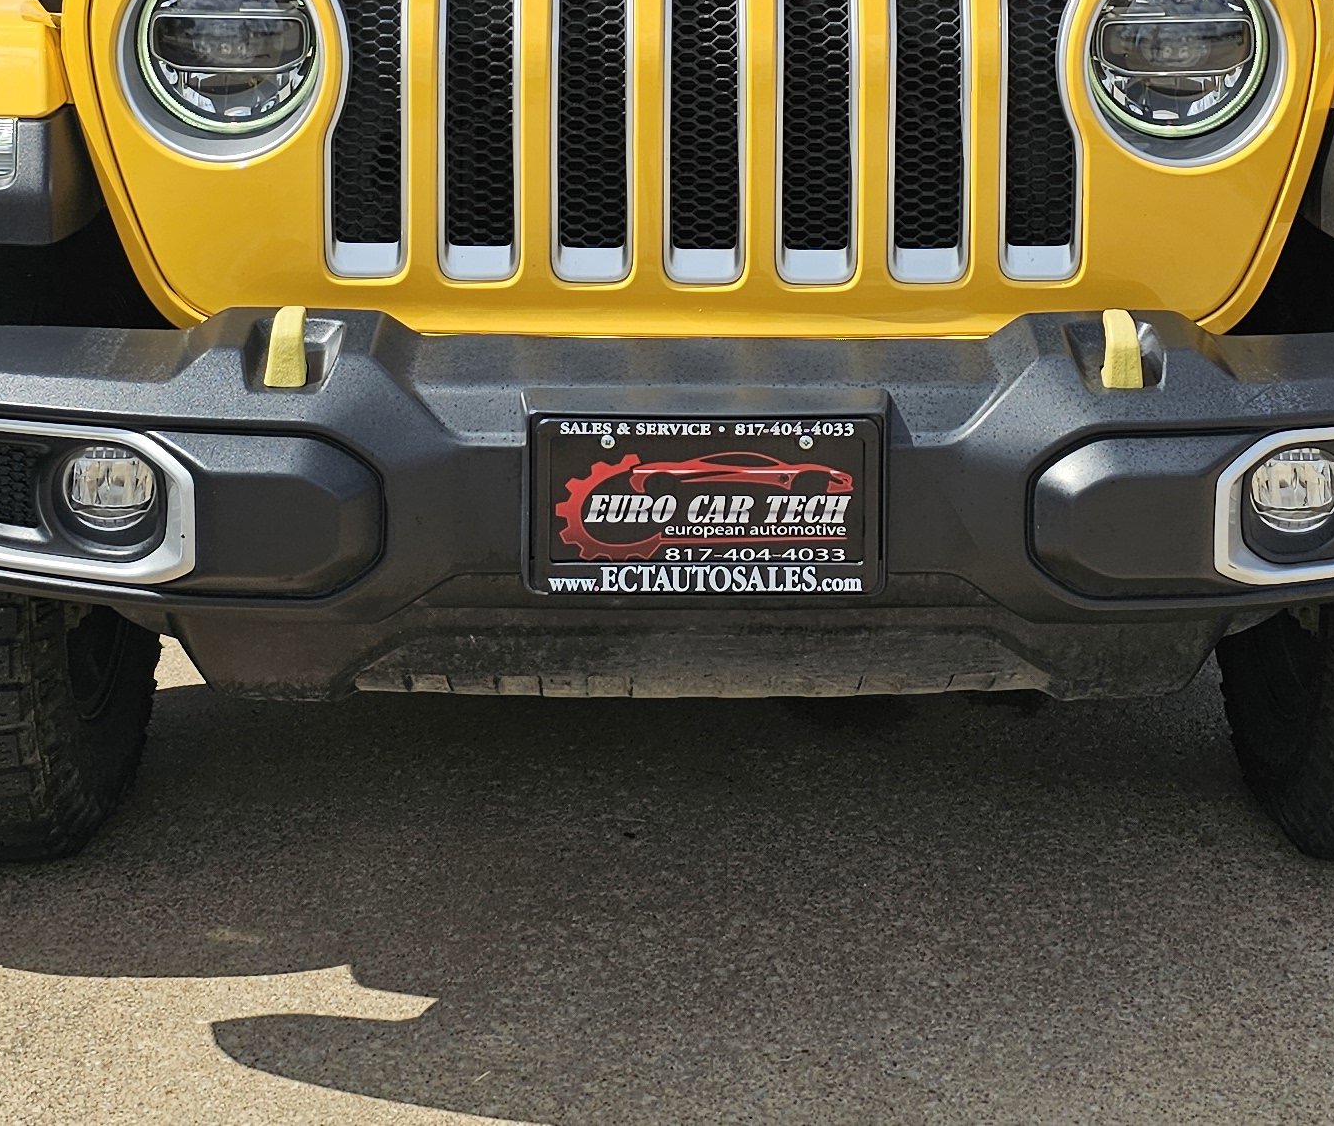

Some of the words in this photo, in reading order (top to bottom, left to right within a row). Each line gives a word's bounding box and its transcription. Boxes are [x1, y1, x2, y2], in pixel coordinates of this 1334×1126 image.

[559, 422, 613, 436] SALES
[616, 423, 631, 436] &
[635, 422, 712, 436] SERVICE
[734, 421, 855, 437] 817-404-4033
[583, 494, 677, 524] EURO
[686, 494, 755, 524] CAR
[763, 494, 852, 524] TECH
[664, 525, 746, 539] european
[749, 524, 847, 537] automotive
[664, 547, 847, 562] 817-404-4033
[547, 565, 863, 593] www.ECTAUTOSALES.com
